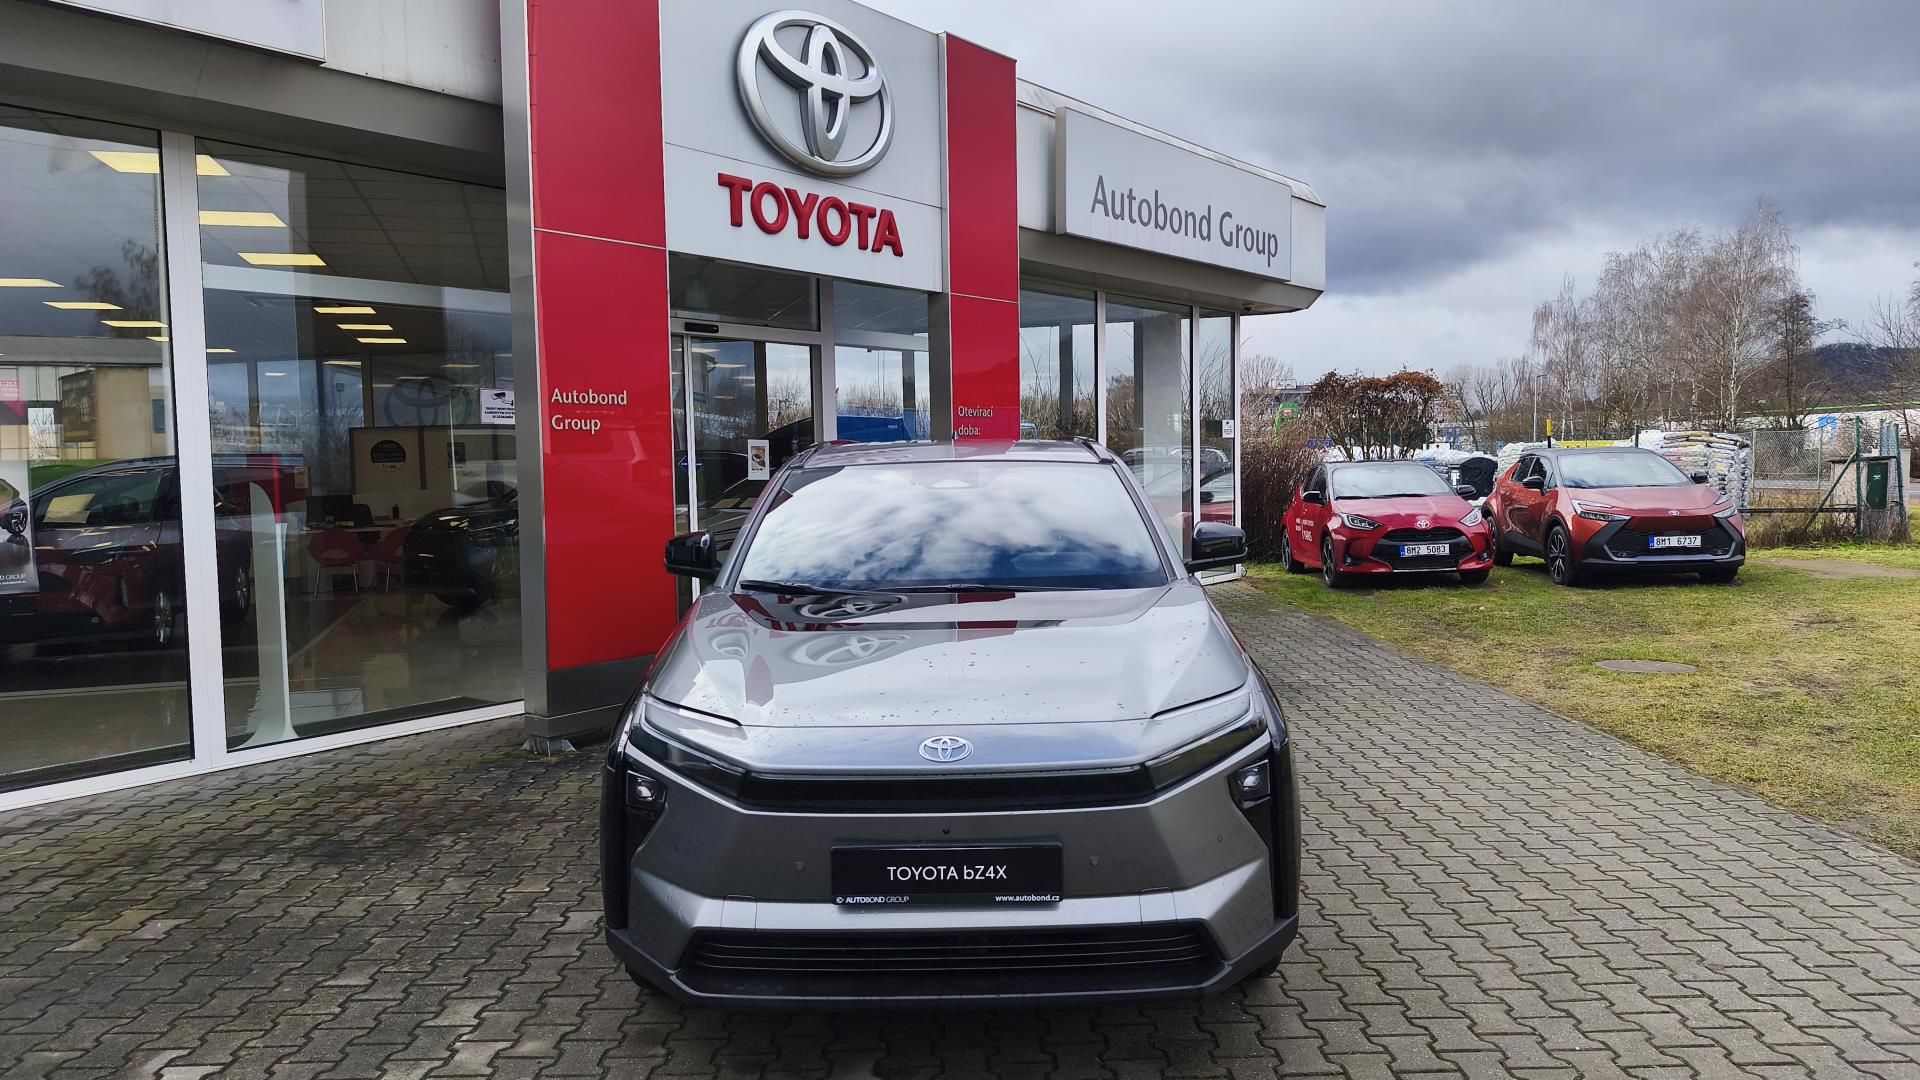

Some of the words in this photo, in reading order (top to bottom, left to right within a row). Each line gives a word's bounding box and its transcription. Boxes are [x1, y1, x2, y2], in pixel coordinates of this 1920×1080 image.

[717, 172, 904, 258] TOYOTA
[1090, 175, 1212, 242] Autobond
[1219, 211, 1279, 267] Group
[551, 387, 627, 405] Autobond
[958, 404, 994, 417] Otevírací
[551, 414, 601, 435] Group
[958, 423, 981, 435] doba:
[1655, 537, 1671, 546] 8M1
[1677, 536, 1697, 545] 6737
[1406, 546, 1421, 554] 8M2
[1426, 545, 1446, 554] 5083
[886, 866, 959, 881] TOYOTA
[963, 864, 1007, 880] bZ4X
[845, 896, 885, 904] AUTOBOND
[995, 893, 1060, 902] www.autobond.cz
